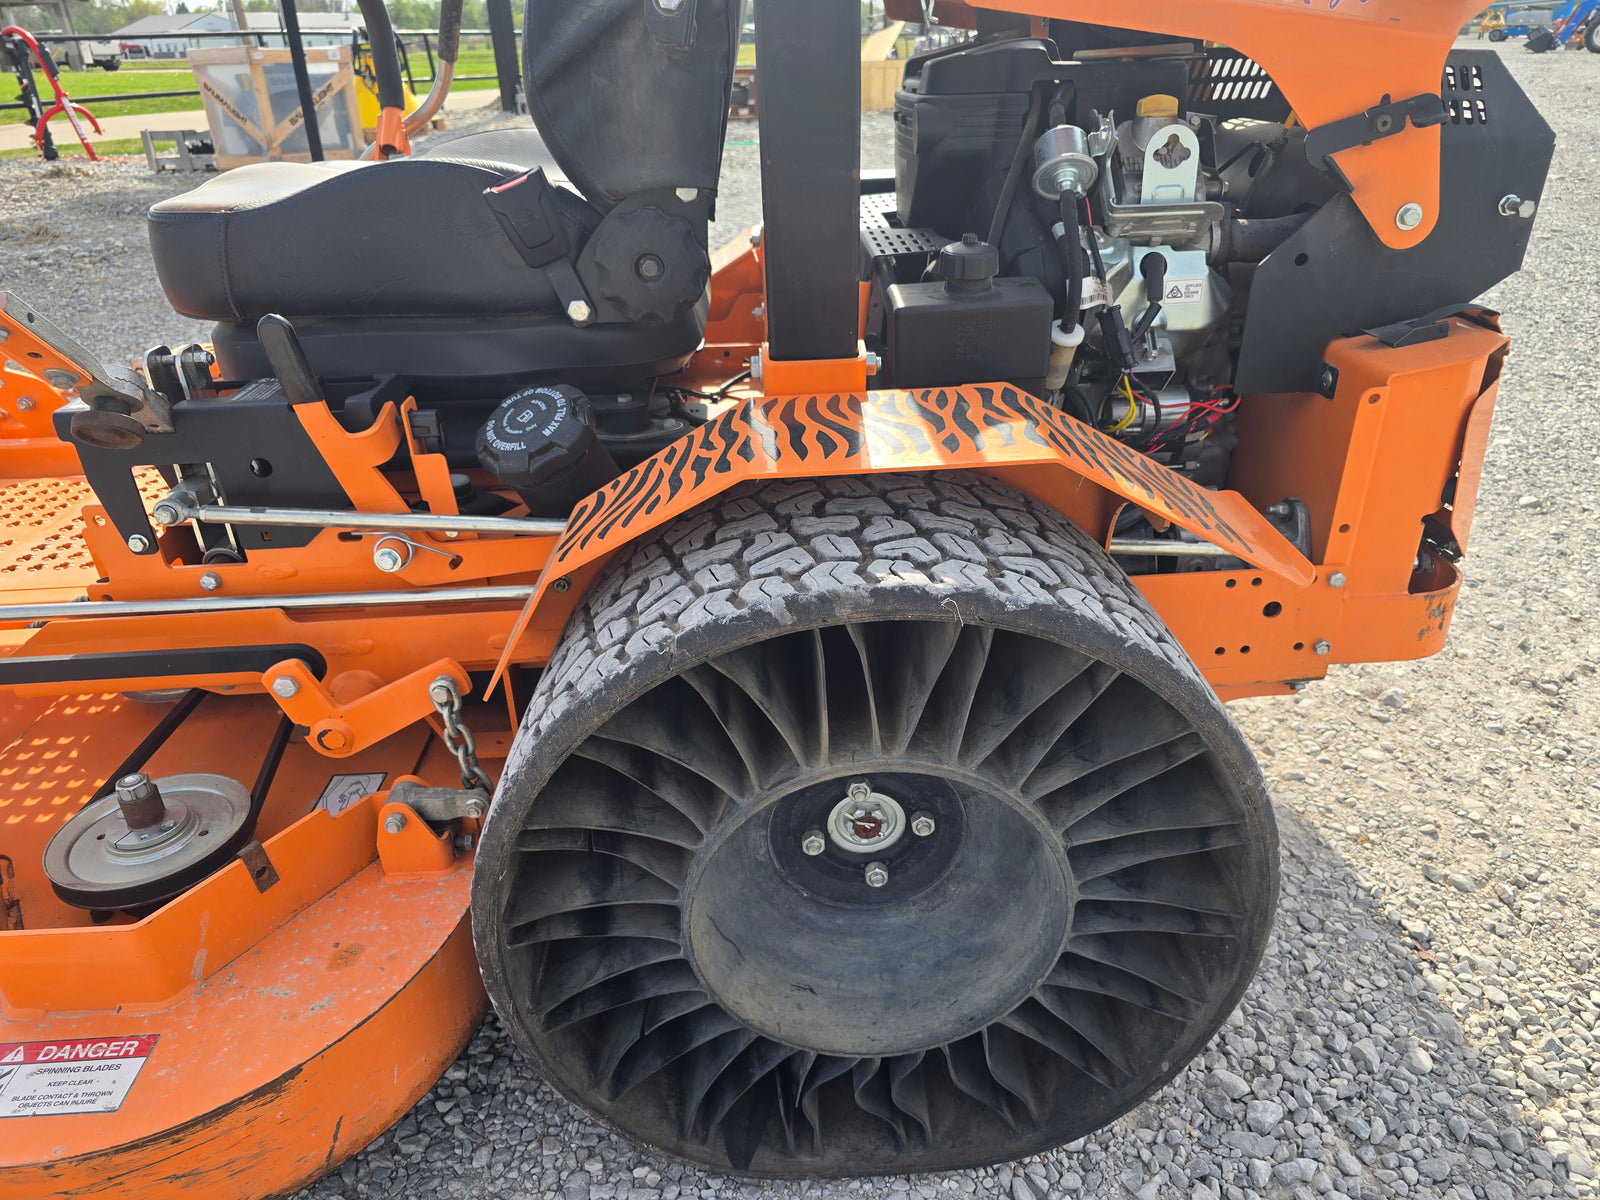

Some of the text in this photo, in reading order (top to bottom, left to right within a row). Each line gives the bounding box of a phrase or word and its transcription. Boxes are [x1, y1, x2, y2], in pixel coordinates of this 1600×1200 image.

[523, 389, 535, 397] OF
[535, 387, 563, 400] BOTTOM
[501, 394, 522, 408] TUBE
[557, 398, 567, 407] TO
[554, 407, 567, 421] FILL
[486, 420, 527, 451] DO NOT OVERFILL
[542, 421, 560, 437] MAX
[36, 1041, 139, 1061] DANGER
[35, 1064, 122, 1075] SPINNING BLADES
[11, 1094, 37, 1102] BLADE
[38, 1092, 72, 1101] CONTACT
[81, 1090, 113, 1098] THROWN
[70, 1098, 98, 1106] INJURE
